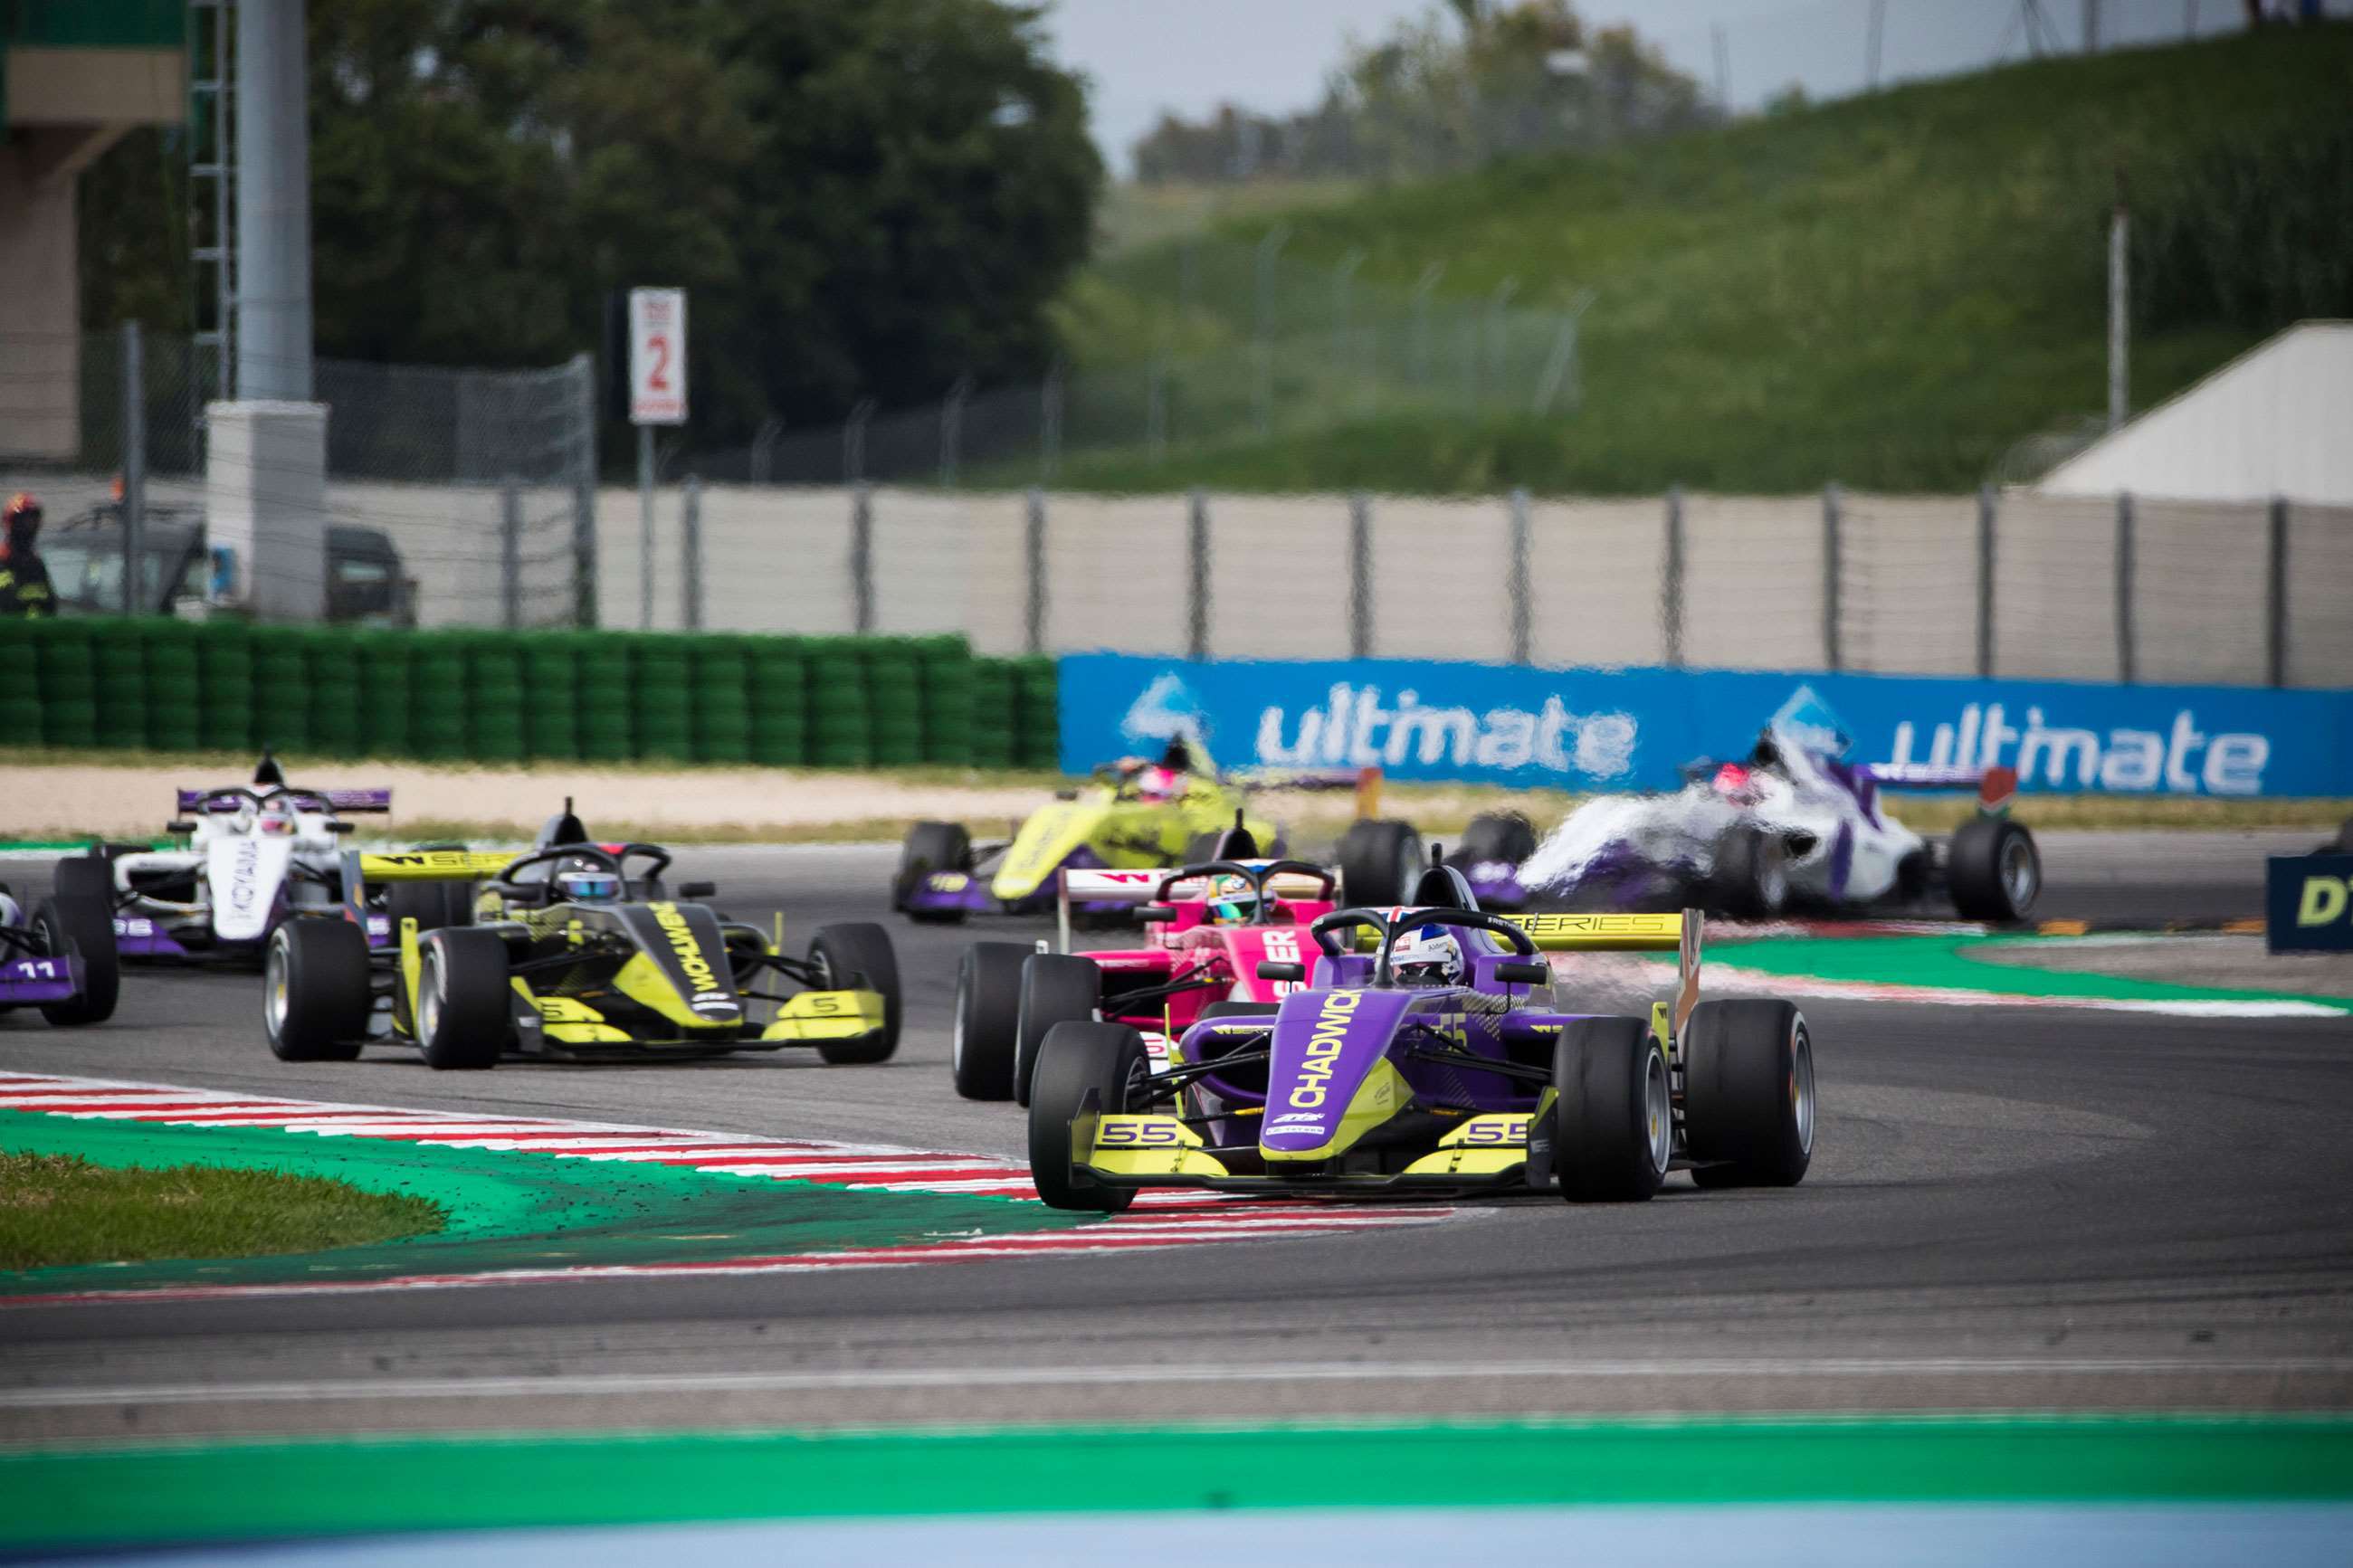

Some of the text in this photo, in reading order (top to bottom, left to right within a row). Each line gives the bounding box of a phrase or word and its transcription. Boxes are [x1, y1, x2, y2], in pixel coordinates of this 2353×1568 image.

[646, 335, 672, 391] 2
[1254, 681, 1638, 780] ultimate
[1890, 702, 2270, 794] ultimate
[17, 961, 55, 979] 11
[813, 997, 839, 1012] 5
[1289, 989, 1365, 1107] CHADWICK
[1101, 1123, 1176, 1144] 55
[1466, 1123, 1528, 1143] 55
